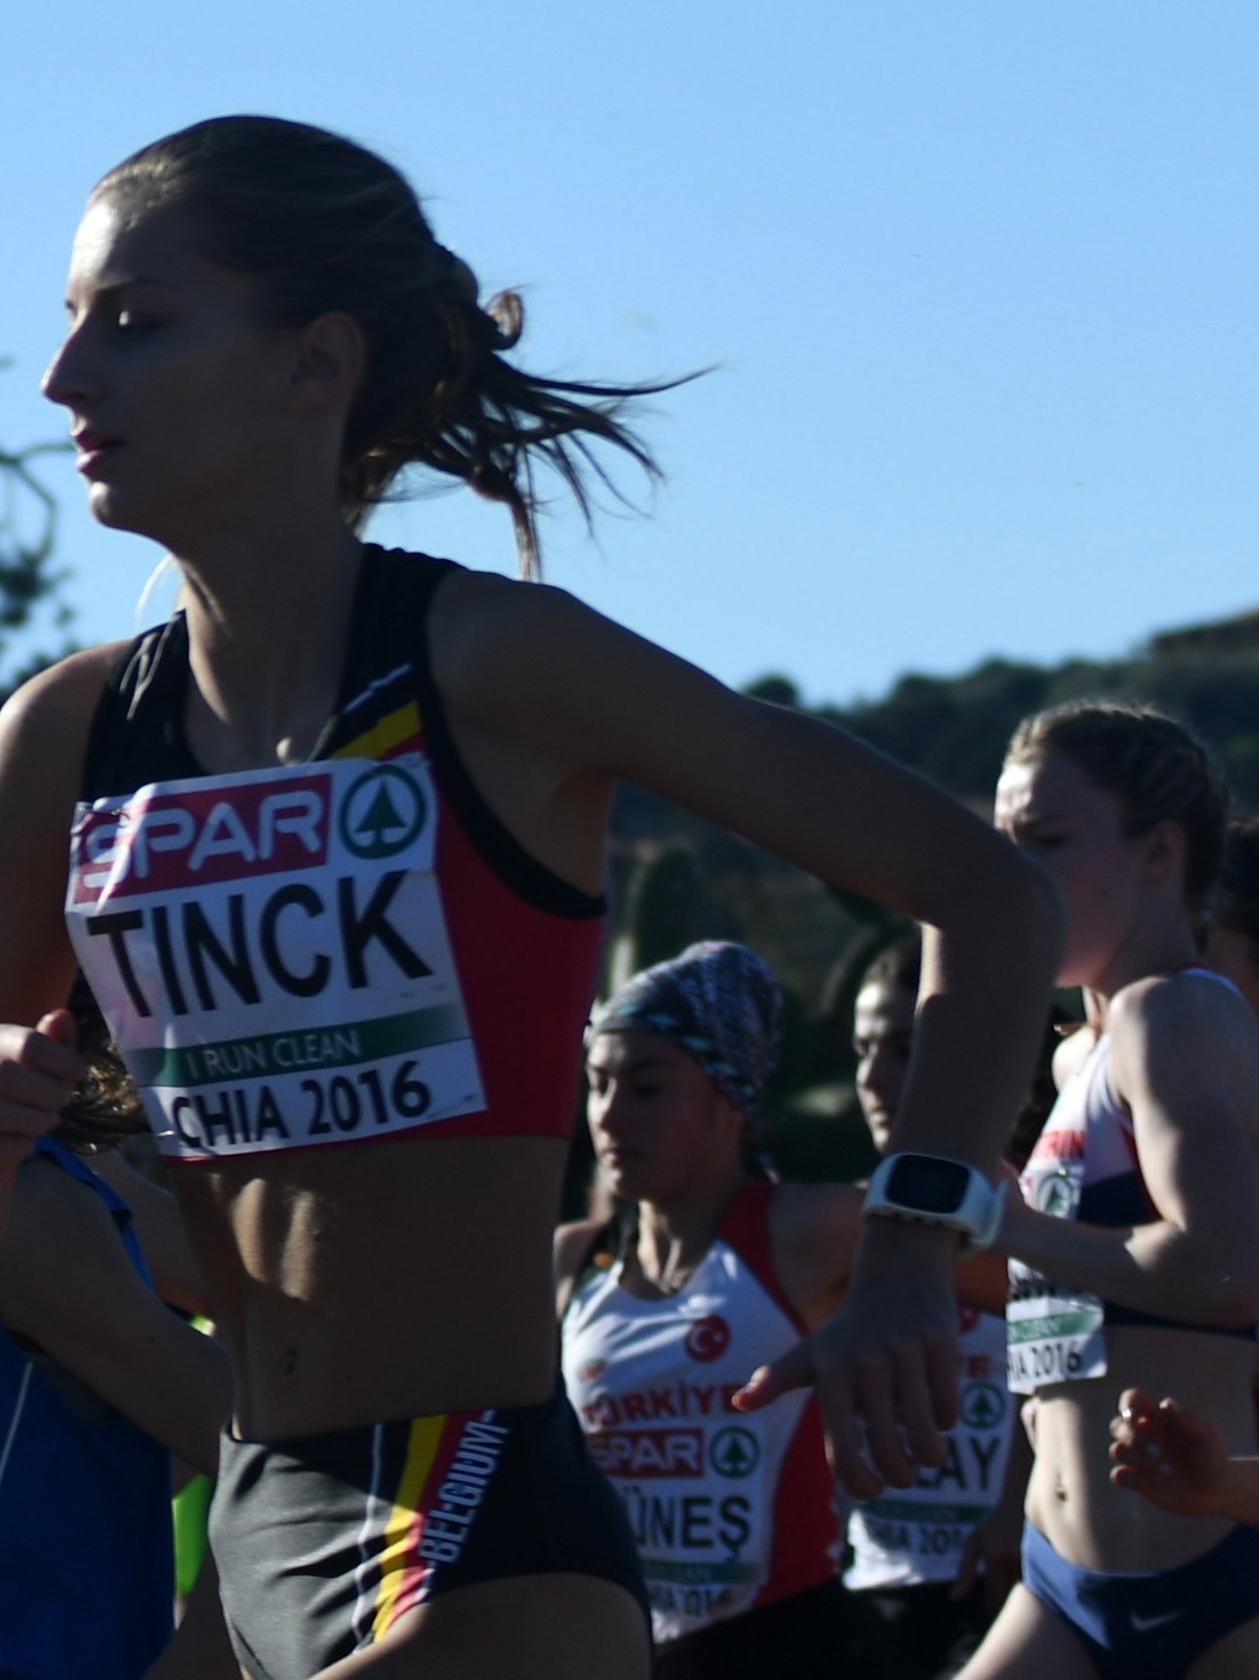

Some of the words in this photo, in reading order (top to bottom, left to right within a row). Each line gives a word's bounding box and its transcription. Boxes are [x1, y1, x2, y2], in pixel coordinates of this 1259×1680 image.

[83, 789, 324, 890] SPAR
[86, 869, 433, 1017] TINCK
[206, 1045, 269, 1076] RUN
[273, 1028, 363, 1069] CLEAN
[172, 1087, 290, 1147] CHIA
[301, 1060, 432, 1135] 2016
[419, 1420, 510, 1564] BELGIUM
